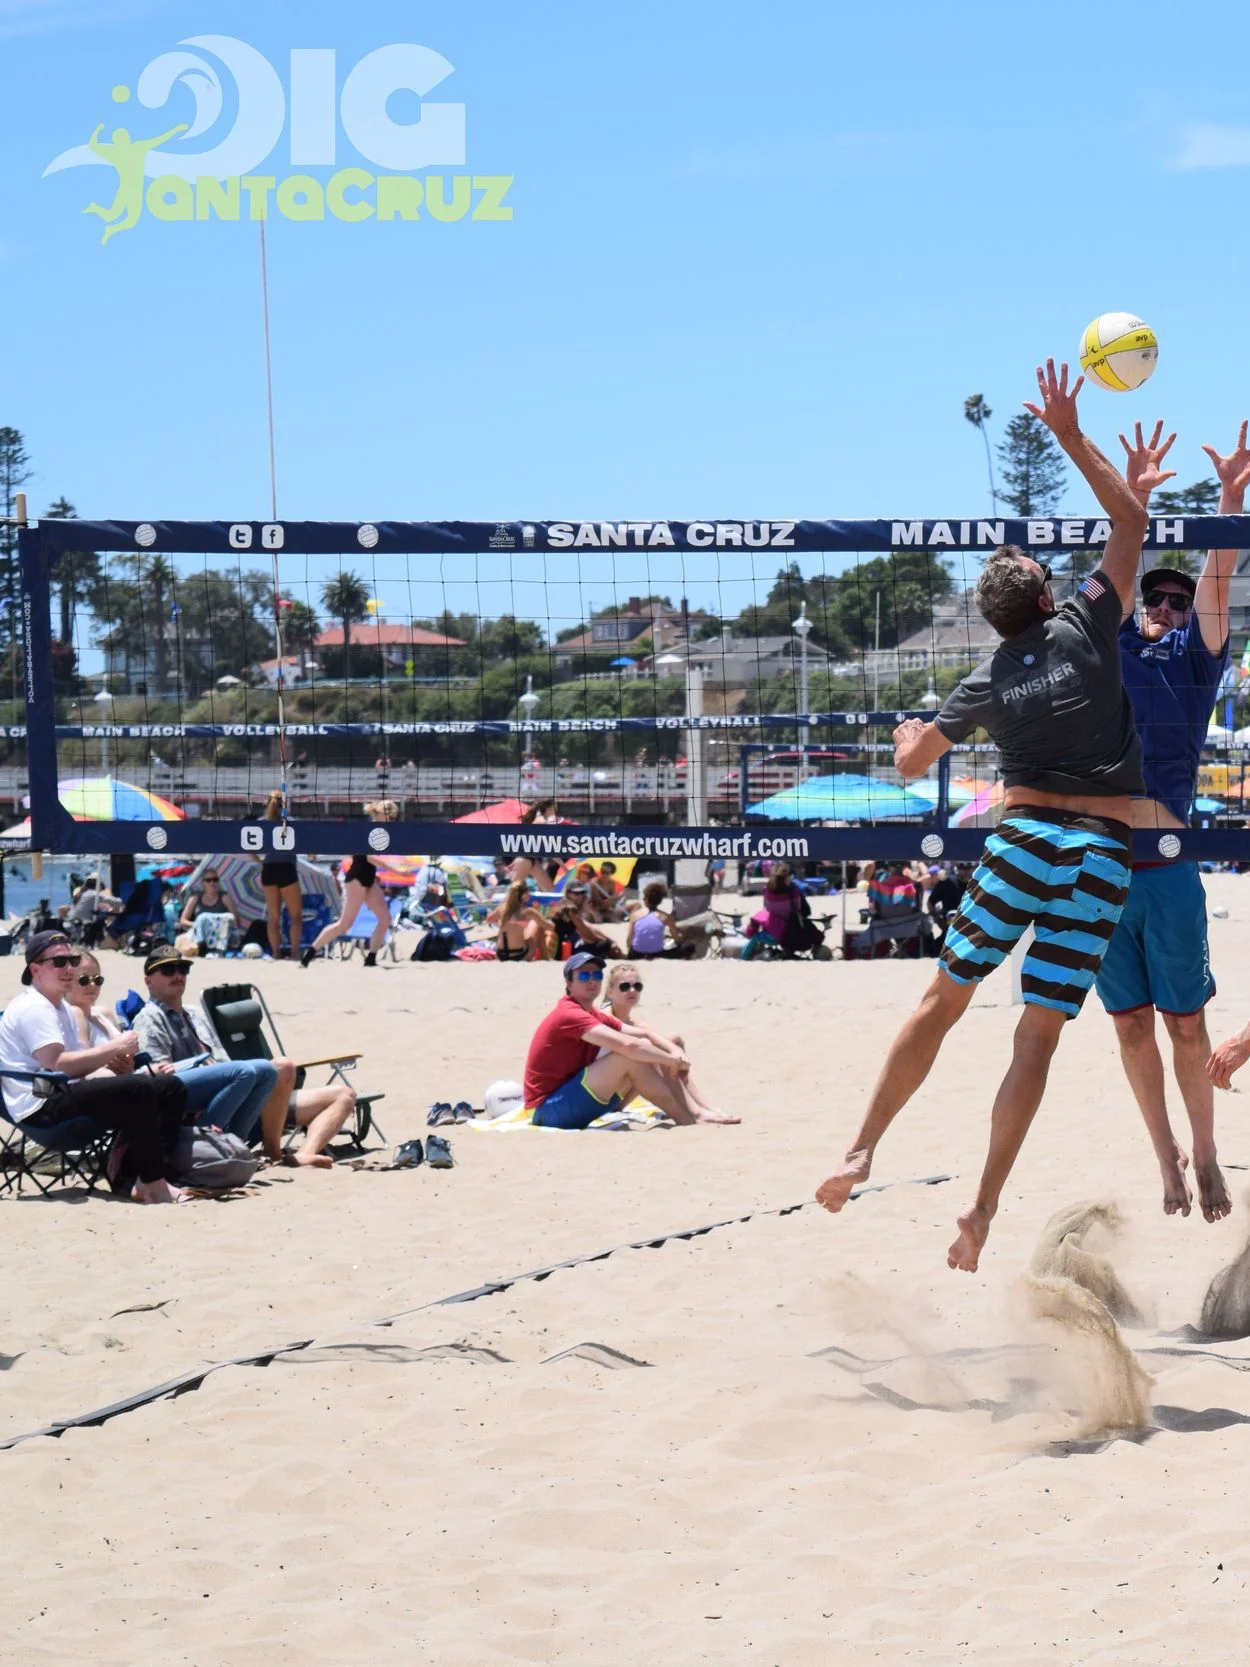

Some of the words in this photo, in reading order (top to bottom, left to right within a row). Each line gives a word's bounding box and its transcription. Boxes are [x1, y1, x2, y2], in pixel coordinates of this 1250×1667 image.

[547, 523, 675, 548] SANTA
[685, 523, 796, 547] CRUZ
[890, 521, 1005, 545] MAIN
[1027, 519, 1184, 545] BEAH
[1002, 662, 1076, 705] FINISHER
[82, 727, 122, 738] MAIN
[129, 726, 186, 737] BEACH
[222, 724, 328, 737] VOLLEYBALL
[382, 722, 431, 734] SANTA
[434, 722, 476, 733] CRUZ
[509, 721, 551, 732] MAIN
[558, 719, 617, 731] BEACH
[655, 716, 761, 729] VOLLEYBALL
[500, 832, 809, 858] www.santacruzwharf.com
